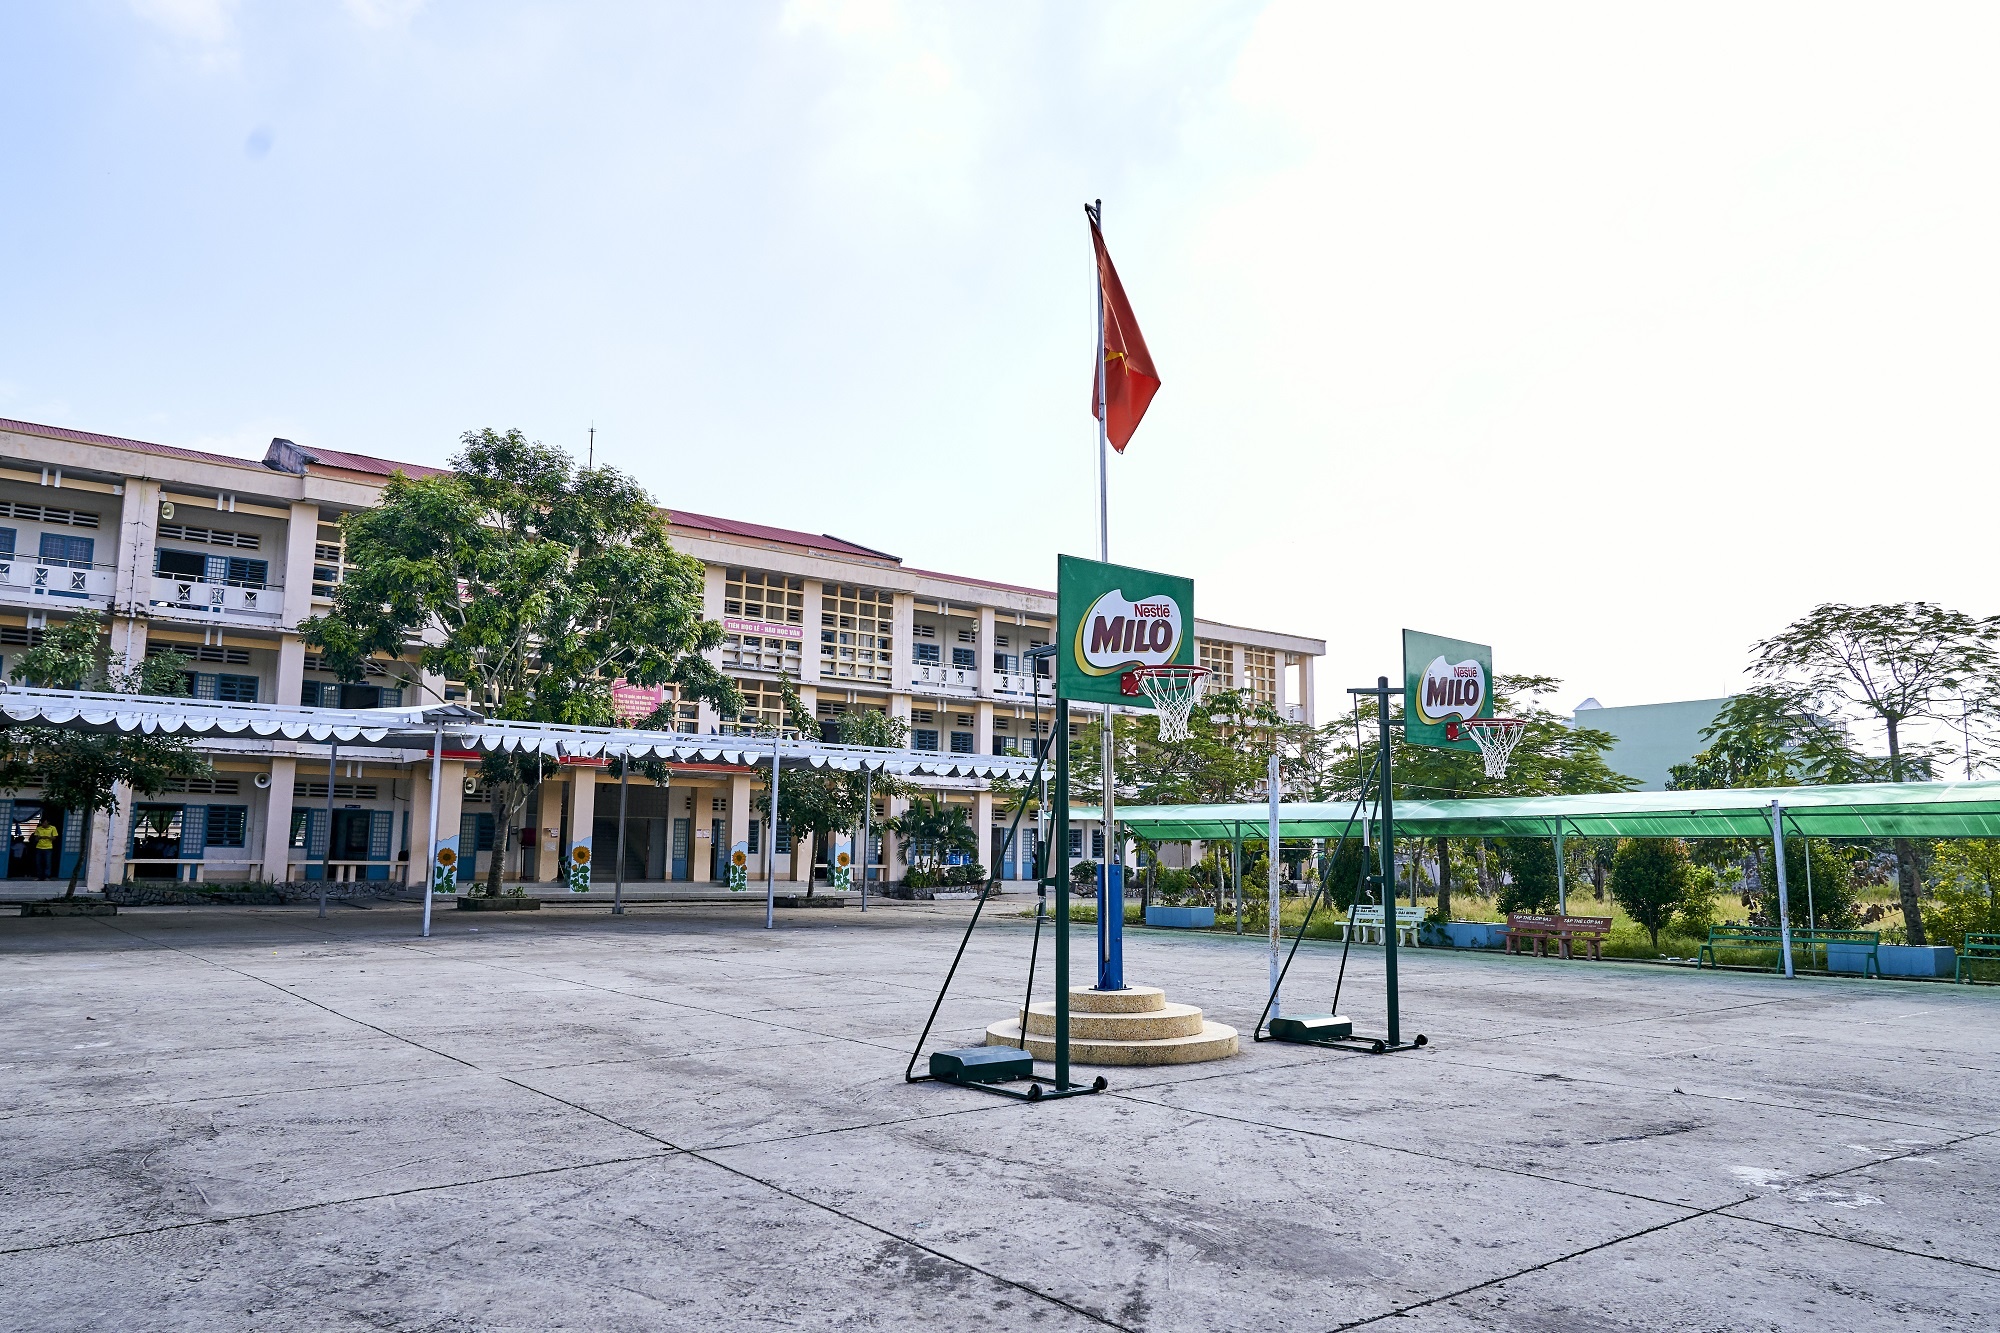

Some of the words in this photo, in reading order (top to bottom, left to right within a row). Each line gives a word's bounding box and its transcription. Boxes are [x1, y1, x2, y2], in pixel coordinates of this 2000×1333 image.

[1134, 603, 1171, 618] Nestlé
[741, 623, 753, 631] HỌC
[1090, 615, 1173, 654] MILO
[1453, 666, 1478, 678] Nestlé
[1426, 676, 1479, 707] MILO
